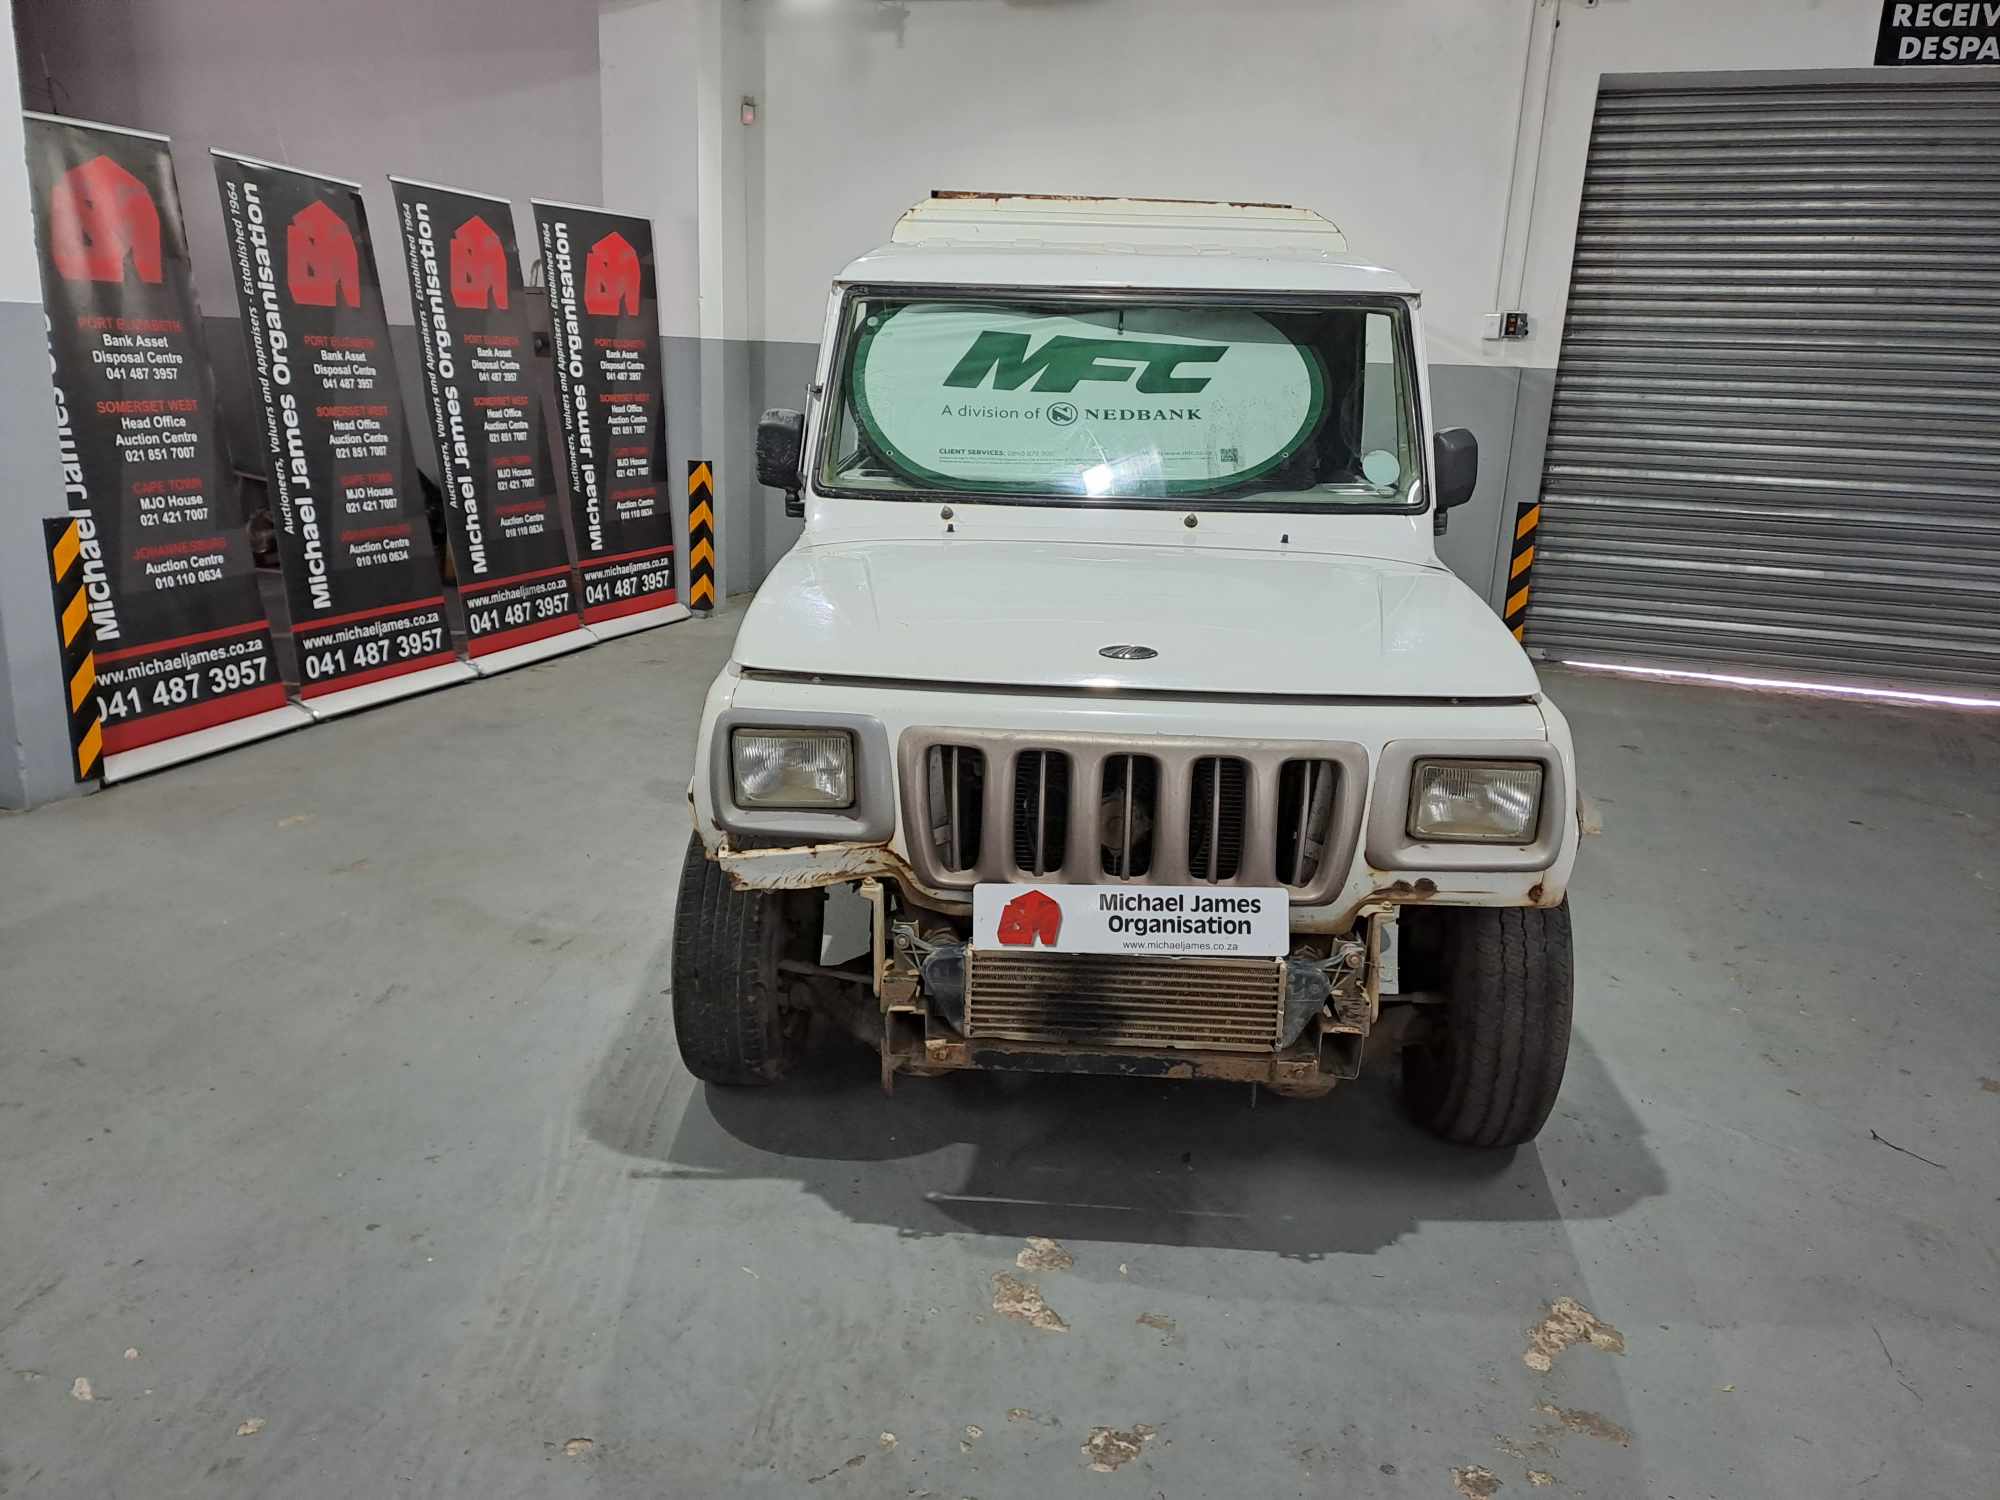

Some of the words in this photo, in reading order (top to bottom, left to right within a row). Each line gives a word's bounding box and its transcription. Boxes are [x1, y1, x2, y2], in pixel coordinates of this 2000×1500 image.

[1892, 3, 2000, 27] RECEIV
[1898, 36, 2000, 60] DESPA
[226, 181, 240, 215] 1964
[402, 202, 414, 232] 1964
[232, 218, 254, 295] Established
[406, 234, 424, 301] Established
[243, 182, 291, 385] Organisation
[416, 203, 454, 378] Organisation
[555, 222, 583, 378] Organisation
[103, 334, 133, 347] Bank
[136, 335, 168, 348] Asset
[249, 306, 268, 376] Appraisers
[419, 308, 435, 371] Appraisers
[92, 350, 144, 365] Disposal
[147, 352, 183, 364] Centre
[321, 350, 343, 361] Bank
[345, 351, 367, 362] Asset
[942, 330, 1230, 393] MFC
[106, 367, 126, 380] 041
[130, 368, 149, 380] 487
[153, 368, 178, 380] 3957
[314, 364, 351, 376] Disposal
[353, 365, 376, 376] Centre
[558, 372, 568, 392] and
[259, 378, 272, 403] and
[323, 379, 338, 389] 041
[339, 379, 354, 389] 487
[427, 372, 439, 395] and
[96, 400, 165, 414] SOMERSET
[433, 397, 446, 438] Valuers
[941, 406, 953, 417] A
[958, 404, 1018, 420] division
[1024, 407, 1040, 420] of
[1085, 408, 1203, 421] NEDBANK
[121, 417, 151, 430] Head
[153, 416, 186, 428] Office
[265, 406, 281, 453] Valuers
[333, 420, 355, 430] Head
[358, 419, 380, 430] Office
[445, 386, 470, 470] James
[574, 384, 593, 458] James
[116, 434, 160, 447] Auction
[162, 432, 198, 444] Centre
[280, 394, 310, 489] James
[329, 434, 361, 445] Auction
[363, 433, 389, 443] Centre
[125, 450, 145, 462] 021
[148, 448, 168, 461] 851
[170, 447, 195, 459] 7007
[336, 448, 350, 459] 021
[939, 448, 965, 456] CLIENT
[441, 442, 458, 509] Auctioneers,
[140, 496, 165, 510] MJO
[168, 495, 203, 507] House
[275, 457, 296, 534] Auctioneers,
[367, 487, 394, 497] House
[140, 513, 160, 527] 021
[162, 510, 182, 523] 421
[184, 508, 209, 521] 7007
[346, 502, 361, 513] 021
[362, 500, 377, 510] 421
[581, 464, 603, 551] Michael
[457, 475, 488, 574] Michael
[295, 497, 331, 610] Michael
[350, 542, 382, 554] Auction
[383, 538, 410, 550] Centre
[145, 558, 188, 575] Auction
[190, 553, 224, 568] Centre
[372, 553, 388, 564] 110
[584, 557, 669, 581] www.michaeljames.co.za
[70, 508, 120, 641] Michael
[155, 576, 174, 590] 010
[176, 573, 196, 586] 110
[198, 568, 223, 583] 0634
[467, 578, 567, 609] www.michaeljames.co.za
[586, 583, 610, 604] 041
[614, 576, 637, 598] 487
[641, 570, 669, 592] 3957
[470, 609, 500, 634] 041
[505, 602, 531, 625] 487
[536, 593, 569, 618] 3957
[303, 612, 439, 650] www.michaeljames.co.za
[97, 638, 263, 688] ww.michaeljames.co.za
[305, 649, 346, 680] 041
[353, 639, 390, 668] 487
[396, 627, 443, 658] 3957
[153, 673, 200, 707] 487
[208, 657, 267, 694] 3957
[1099, 893, 1184, 913] Michael
[1190, 894, 1261, 914] James
[1108, 915, 1252, 937] Organisation
[1122, 940, 1239, 953] www.michaeljames.co.za
